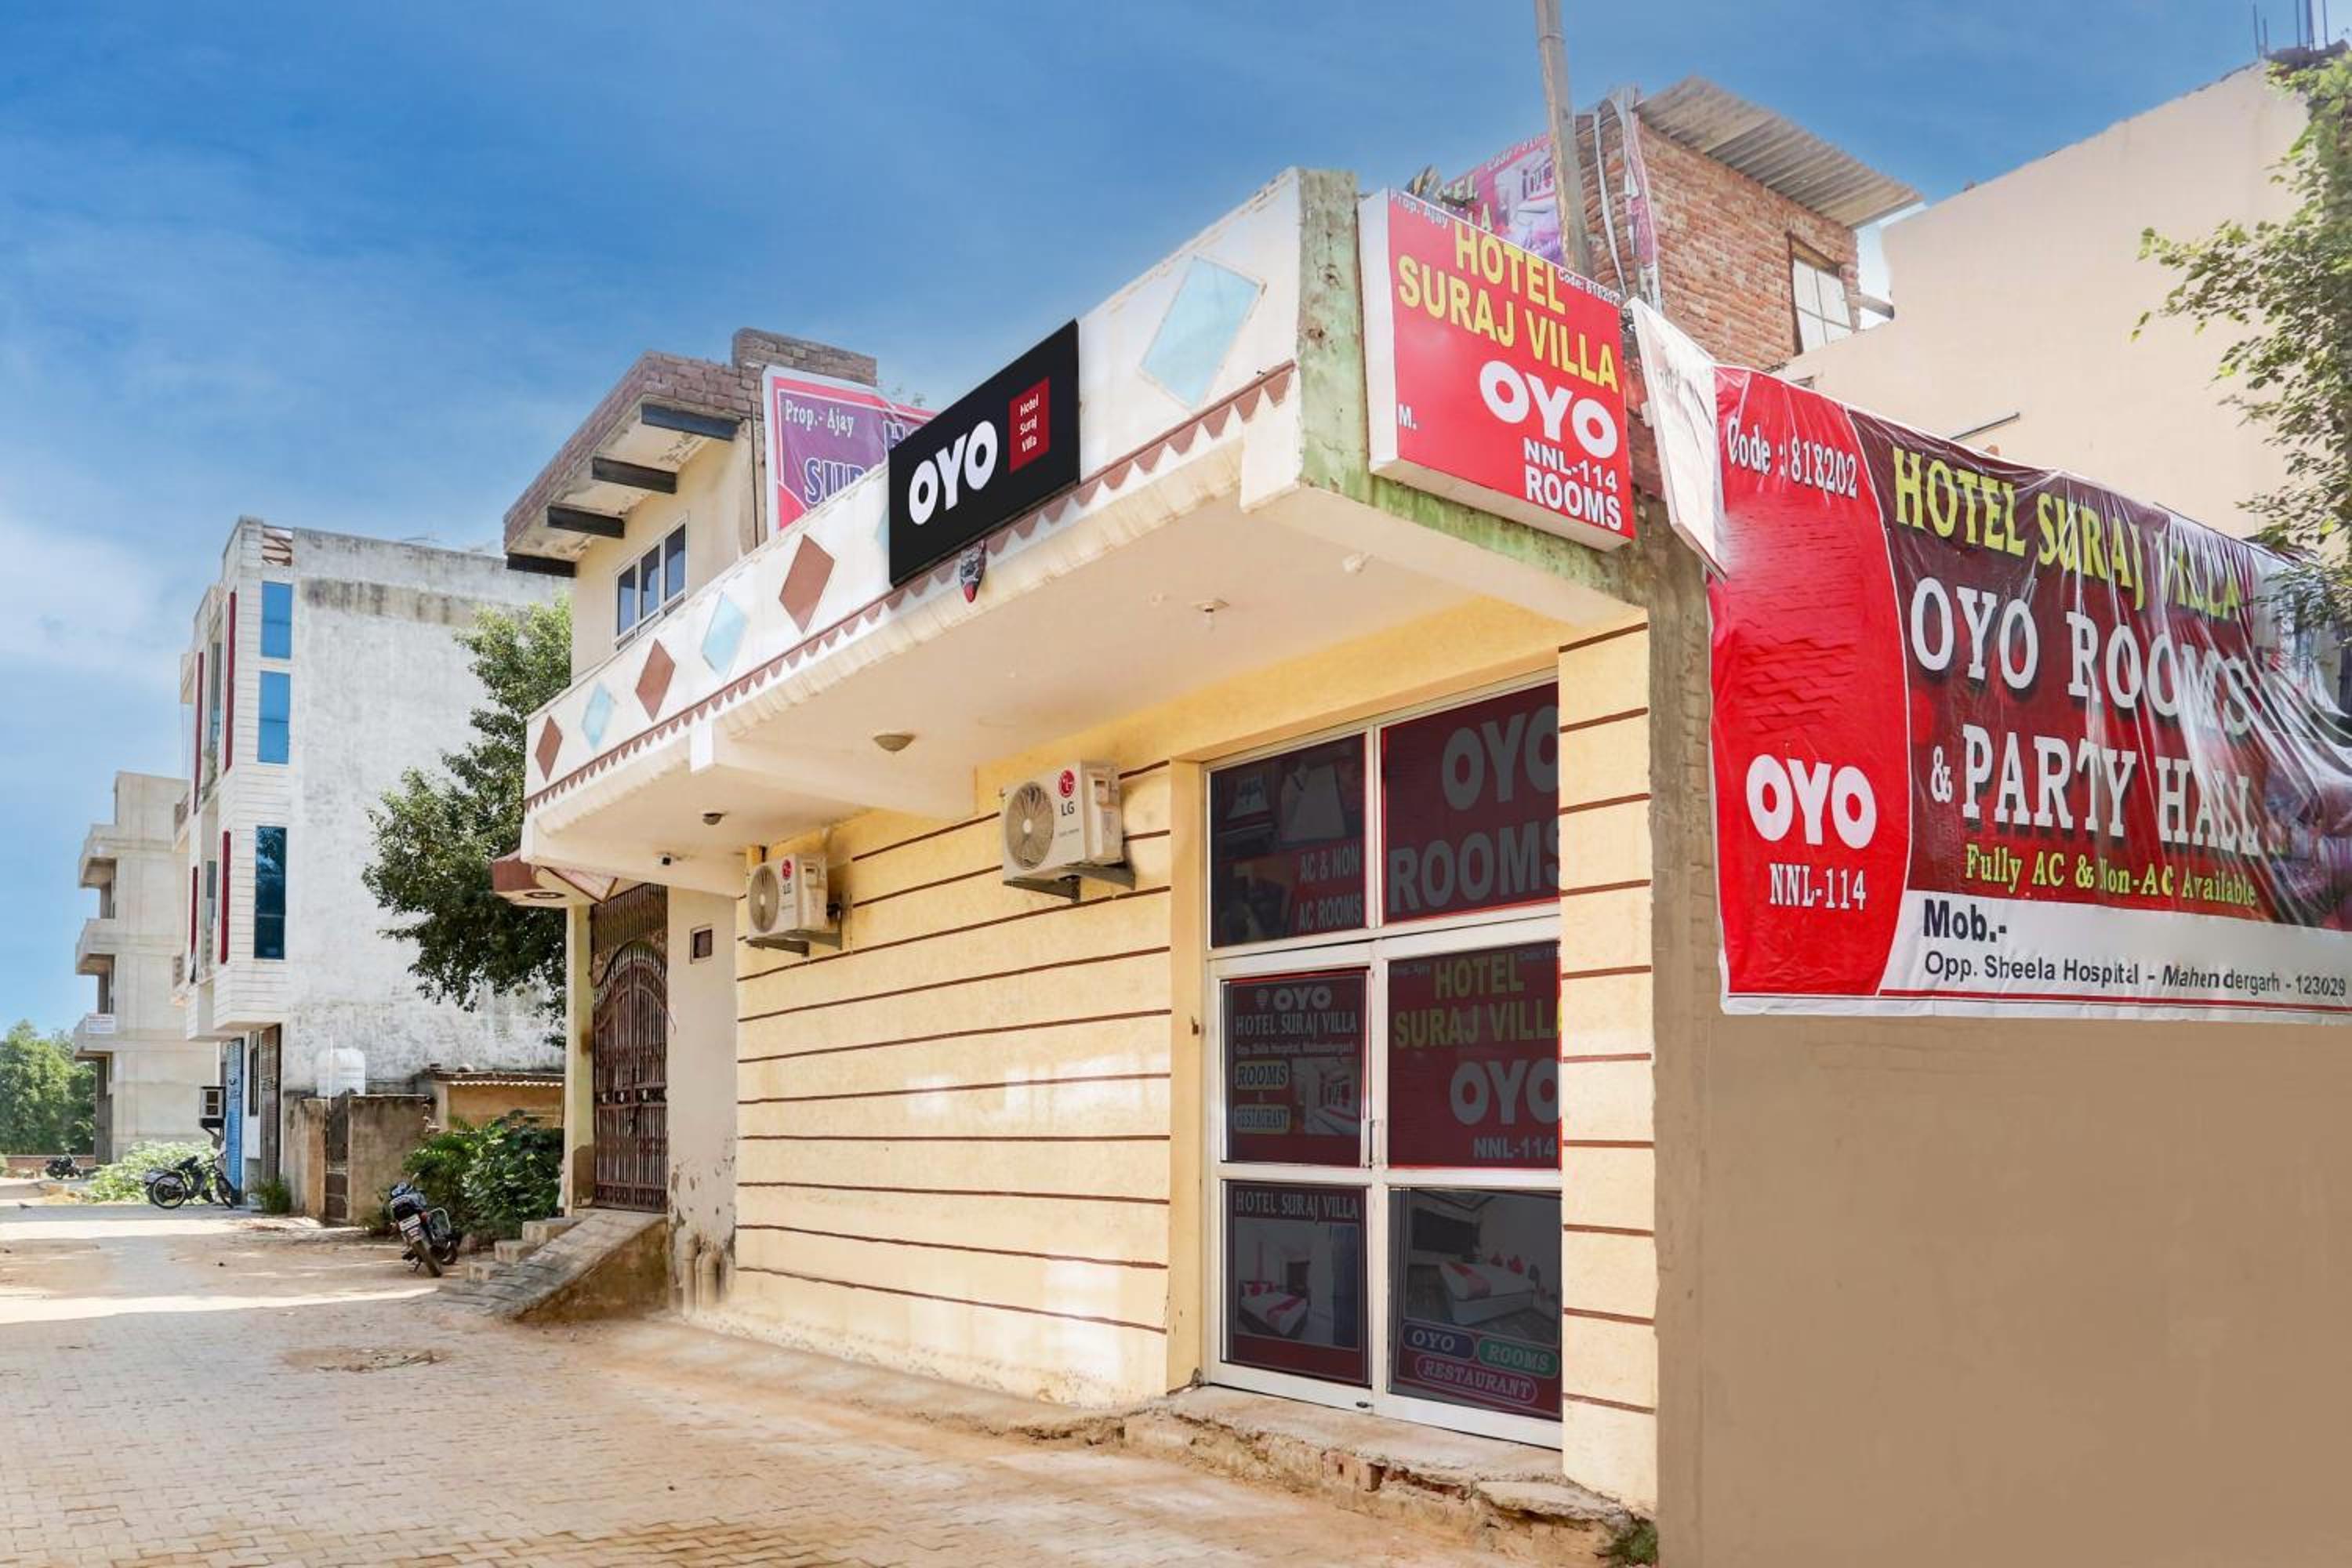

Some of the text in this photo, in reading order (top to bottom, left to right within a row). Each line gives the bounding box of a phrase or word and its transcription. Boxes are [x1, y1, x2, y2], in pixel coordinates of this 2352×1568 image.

[1454, 220, 1566, 314] HOTEL
[1558, 268, 1585, 292] Code:
[1398, 256, 1619, 393] SURAJ VILLA
[827, 408, 854, 437] Ajay
[1020, 393, 1039, 416] Hotel
[1399, 403, 1417, 430] M.
[1479, 360, 1618, 459] OYO
[909, 420, 998, 525] OYO
[1524, 437, 1617, 493] NNL-114
[1790, 442, 1858, 498] 818202
[1525, 465, 1622, 532] ROOMS
[1891, 447, 2027, 558] HOTEL
[2038, 492, 2145, 611] SURAJ
[1910, 577, 2253, 737] OYO ROOMS
[1061, 801, 1075, 816] LG
[1745, 754, 1878, 849] OYO
[1931, 724, 2261, 858] & PARTY HALL
[1769, 863, 1867, 912] NNL-114
[1965, 844, 2022, 893] Fully
[2031, 851, 2065, 888] AC
[2074, 854, 2095, 889] &
[1435, 952, 1524, 1000] HOTEL
[1925, 950, 1979, 980] Opp.
[1984, 955, 2056, 982] Sheela
[2063, 959, 2139, 988] Hospital
[2296, 975, 2346, 996] 123029
[1274, 985, 1331, 1011] OYO
[1236, 1010, 1357, 1038] HOTEL SURAJ VILLA
[1395, 1006, 1479, 1050] SURAJ
[1236, 1064, 1286, 1086] ROOMS
[1450, 1058, 1560, 1127] OYO
[1474, 1137, 1556, 1159] NNL-114
[1235, 1191, 1359, 1221] HOTEL SURAJ VILLA
[1412, 1332, 1456, 1352] OYO
[1489, 1346, 1549, 1371] ROOMS
[1425, 1358, 1531, 1399] RESTAURANT
